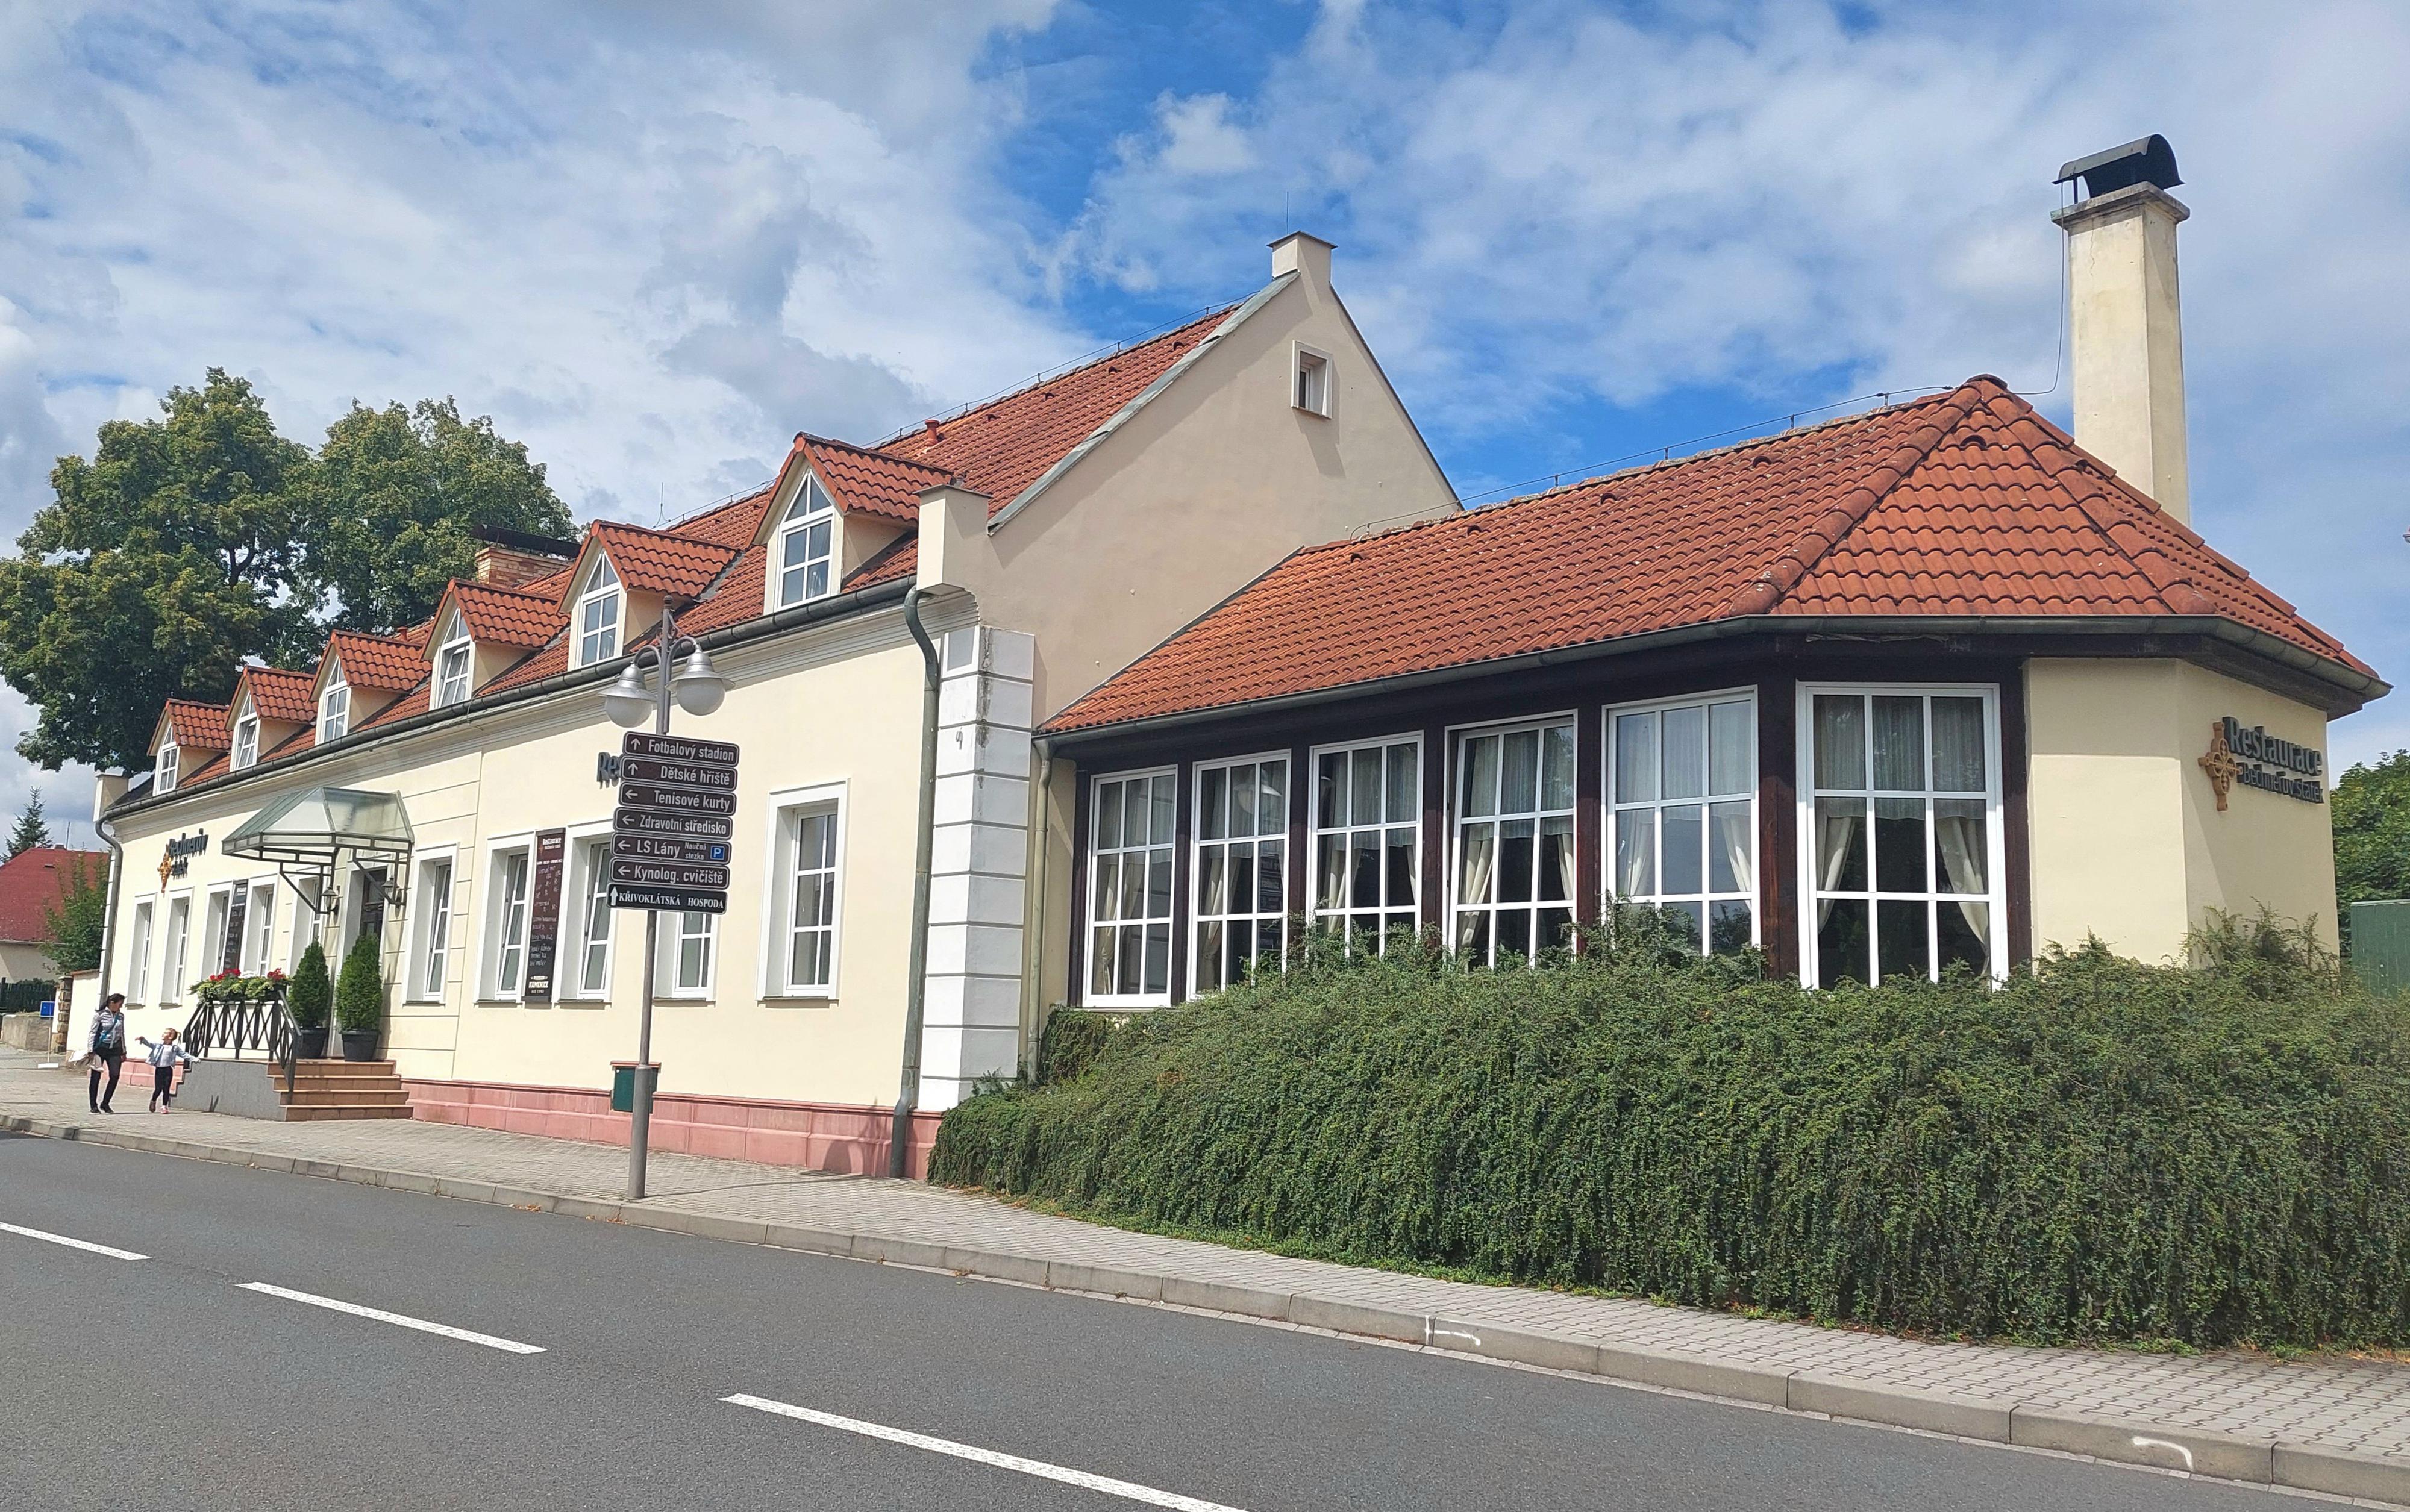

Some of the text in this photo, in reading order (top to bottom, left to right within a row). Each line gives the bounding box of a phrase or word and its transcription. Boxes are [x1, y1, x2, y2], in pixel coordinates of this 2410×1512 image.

[648, 739, 734, 761] Fotbalový stadion
[2223, 716, 2323, 776] Restaurace
[660, 766, 730, 786] Dětské hřiště
[2294, 778, 2324, 803] statek
[654, 790, 730, 812] Tenisové kurty
[639, 814, 727, 834] Zdravotní středisko
[636, 839, 681, 858] LS Lány
[684, 842, 707, 851] Naučná
[634, 865, 724, 884] Kynolog. cvičiště
[619, 890, 724, 908] KŘIVOKLÁTSKÁ HOSPODA
